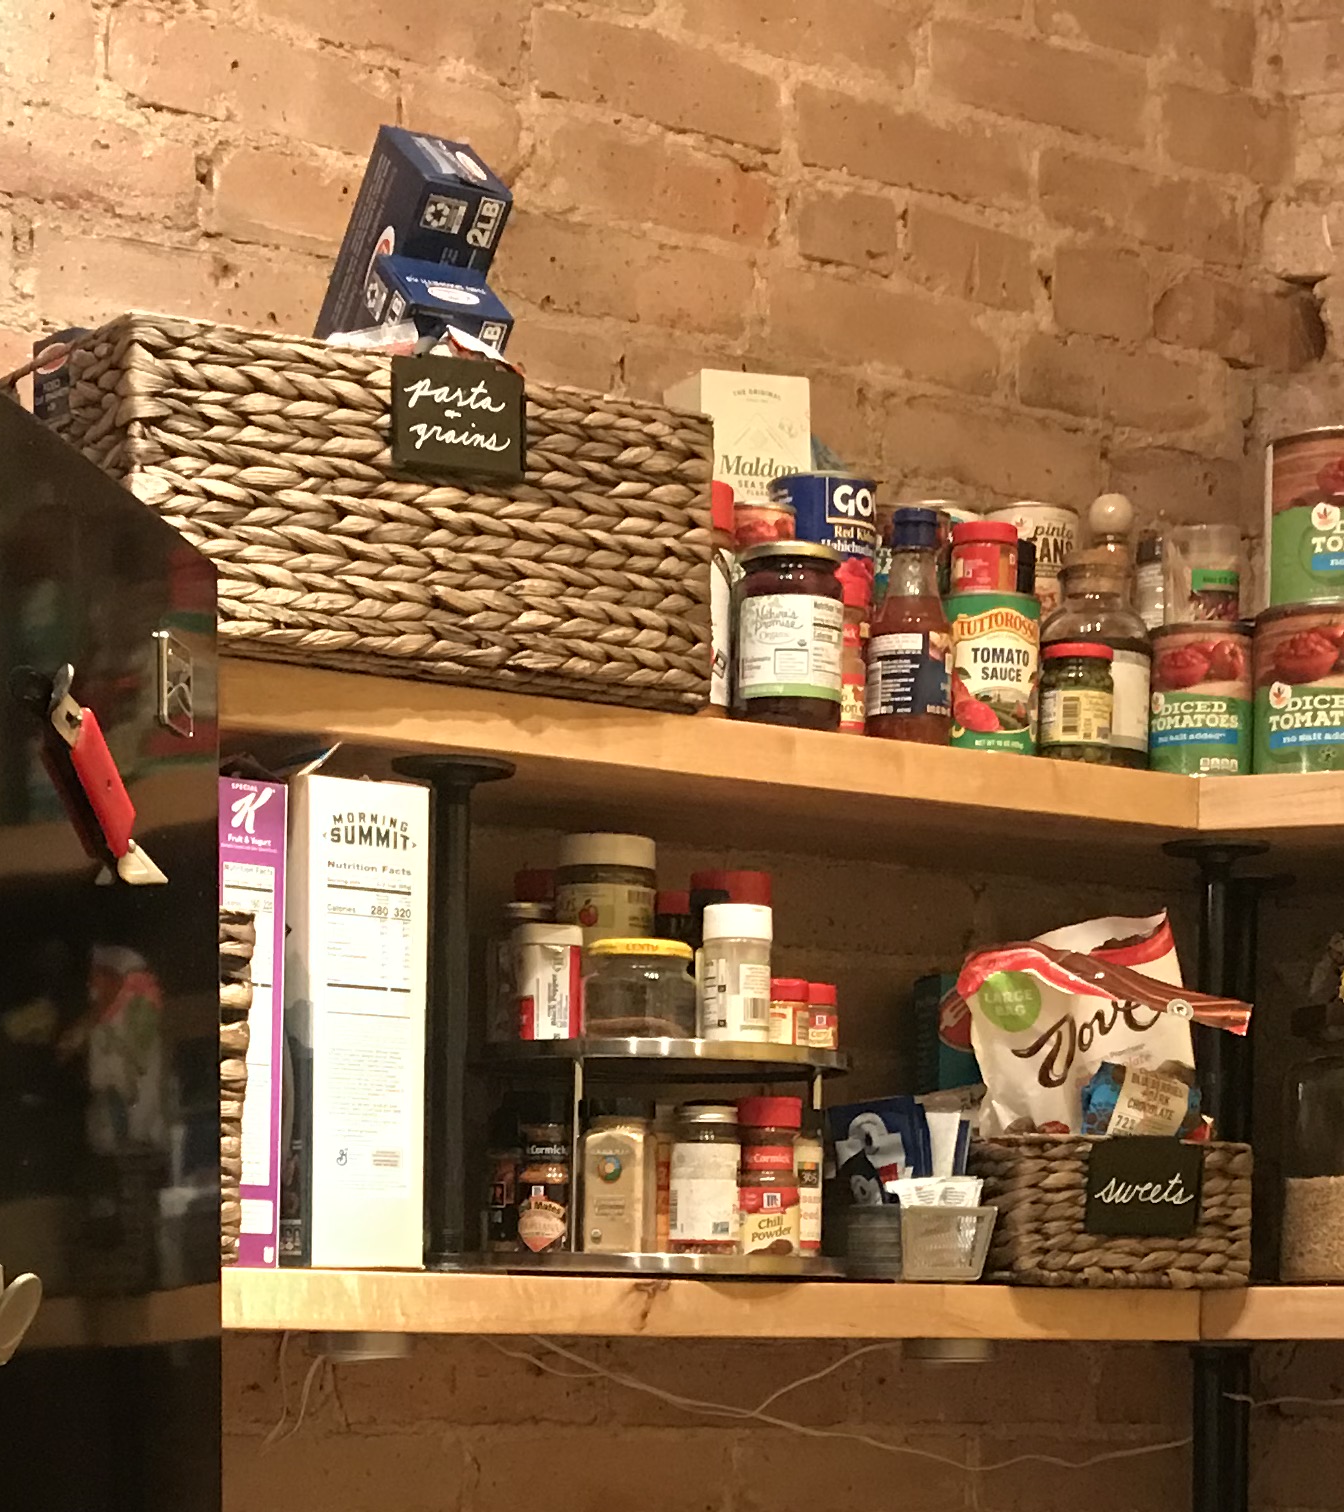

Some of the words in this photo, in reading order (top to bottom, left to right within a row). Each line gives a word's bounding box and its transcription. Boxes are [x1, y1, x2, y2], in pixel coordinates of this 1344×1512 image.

[465, 201, 502, 249] 2LB
[403, 378, 506, 413] pasta
[409, 422, 511, 452] grains
[719, 454, 801, 480] Maldon
[1033, 522, 1074, 541] pinto
[971, 647, 1031, 667] TOMATO
[980, 666, 1024, 684] SAUCE
[1161, 700, 1228, 717] DICED
[1151, 713, 1239, 733] TOMATOES
[1282, 734, 1297, 744] no
[1299, 732, 1322, 743] salt
[231, 782, 258, 792] SPECIAL
[230, 786, 274, 835] K
[332, 812, 409, 833] MORNING
[227, 833, 243, 843] Fruit
[250, 836, 272, 847] Yogurt
[329, 825, 411, 851] SUMMIT
[327, 859, 378, 872] Nutrition
[381, 864, 413, 877] Facts
[370, 904, 389, 918] 280
[393, 907, 413, 919] 320
[984, 990, 1034, 1003] LARGE
[1094, 1172, 1196, 1205] sweets
[758, 1216, 784, 1230] Chili
[751, 1225, 793, 1243] Powder
